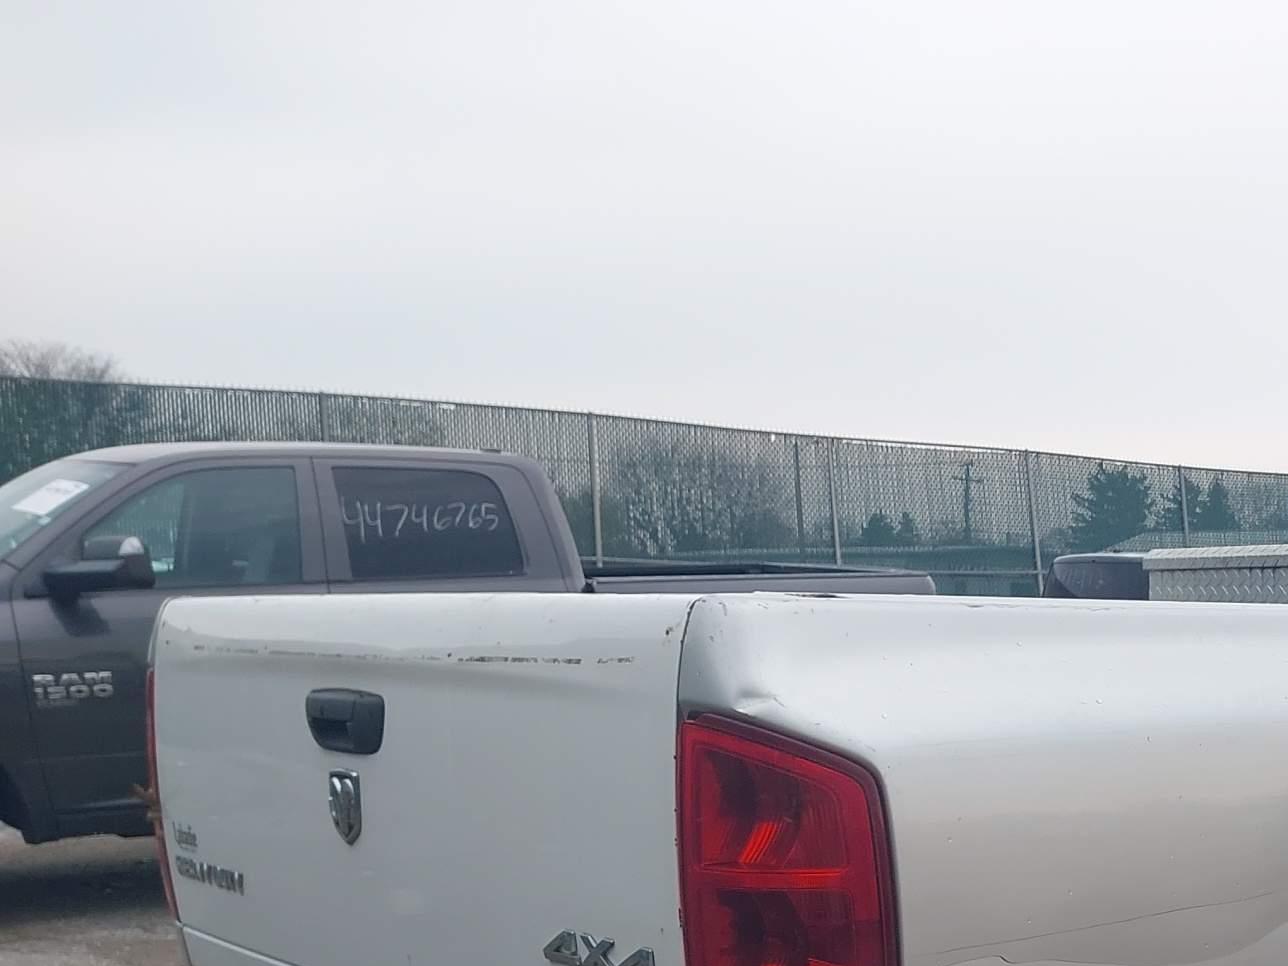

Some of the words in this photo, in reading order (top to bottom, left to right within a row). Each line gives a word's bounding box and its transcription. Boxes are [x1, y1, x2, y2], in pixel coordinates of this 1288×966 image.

[340, 496, 499, 544] 44746765
[32, 671, 113, 688] RAM
[33, 684, 114, 699] 1500
